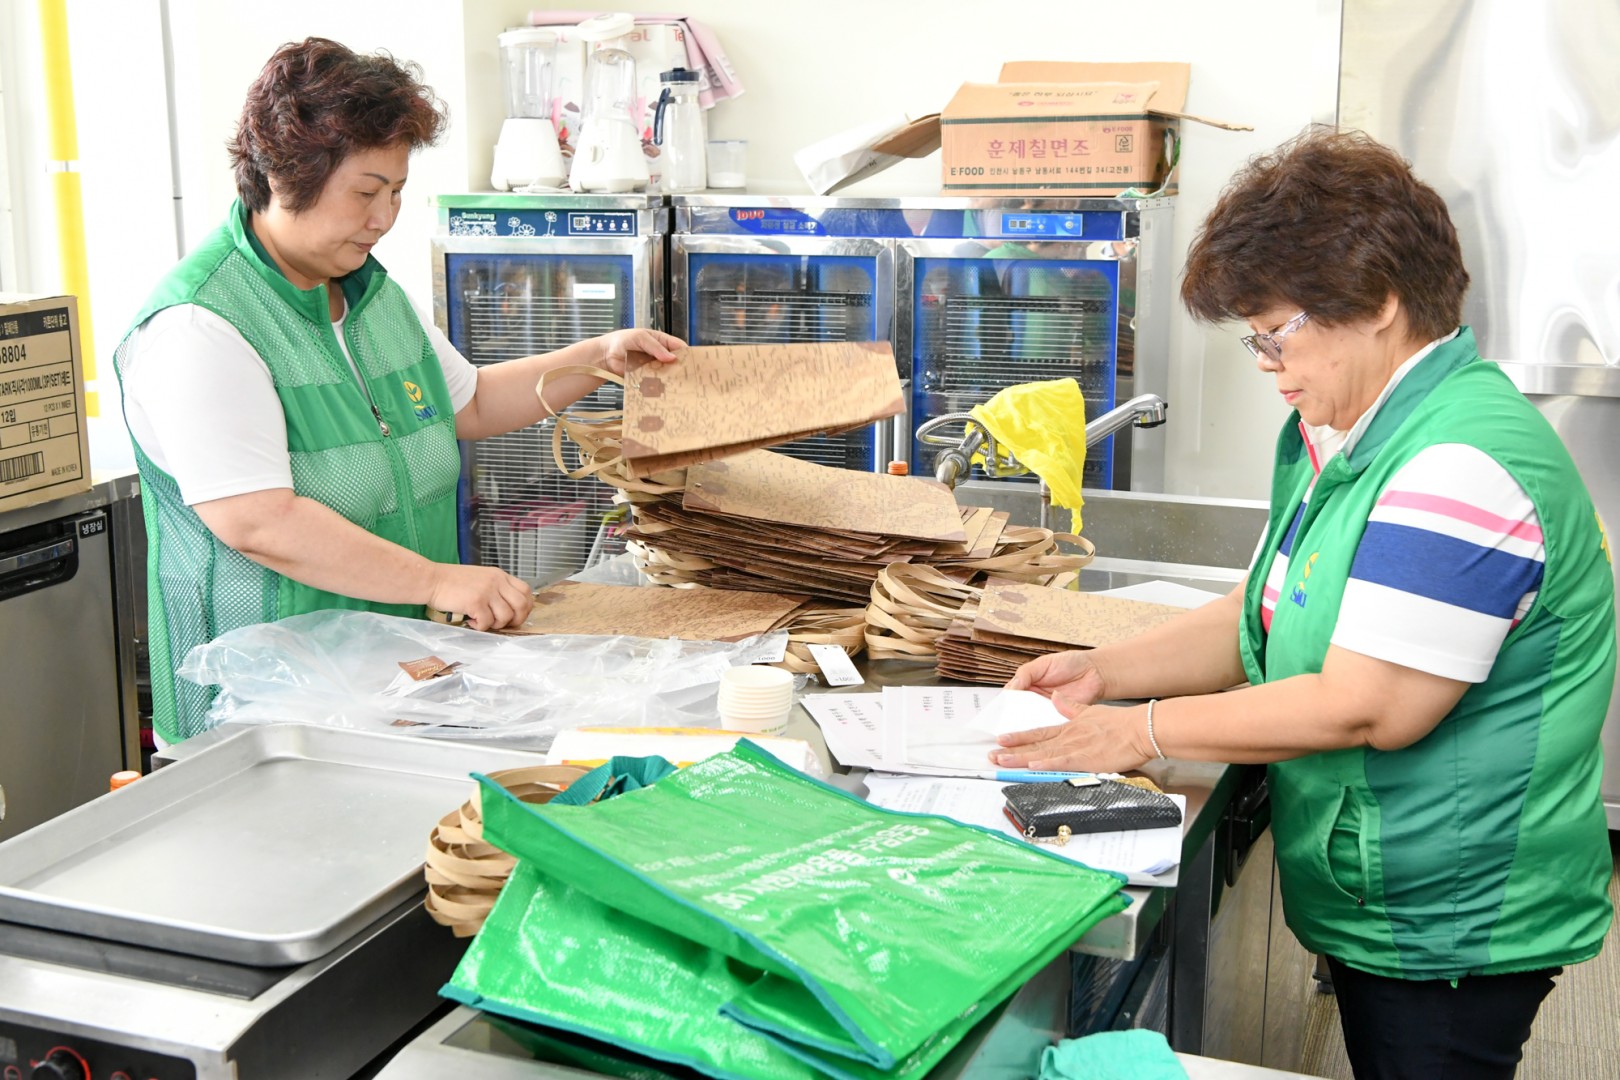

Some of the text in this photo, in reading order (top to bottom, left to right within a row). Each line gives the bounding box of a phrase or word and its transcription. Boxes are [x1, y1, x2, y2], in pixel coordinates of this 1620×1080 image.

[988, 138, 1091, 159] 훈제칠면조
[1012, 166, 1032, 175] 남동구
[1035, 166, 1062, 175] 남동서로
[1066, 165, 1092, 175] 144번길
[1, 408, 16, 423] 12입
[82, 520, 103, 535] 냉장실
